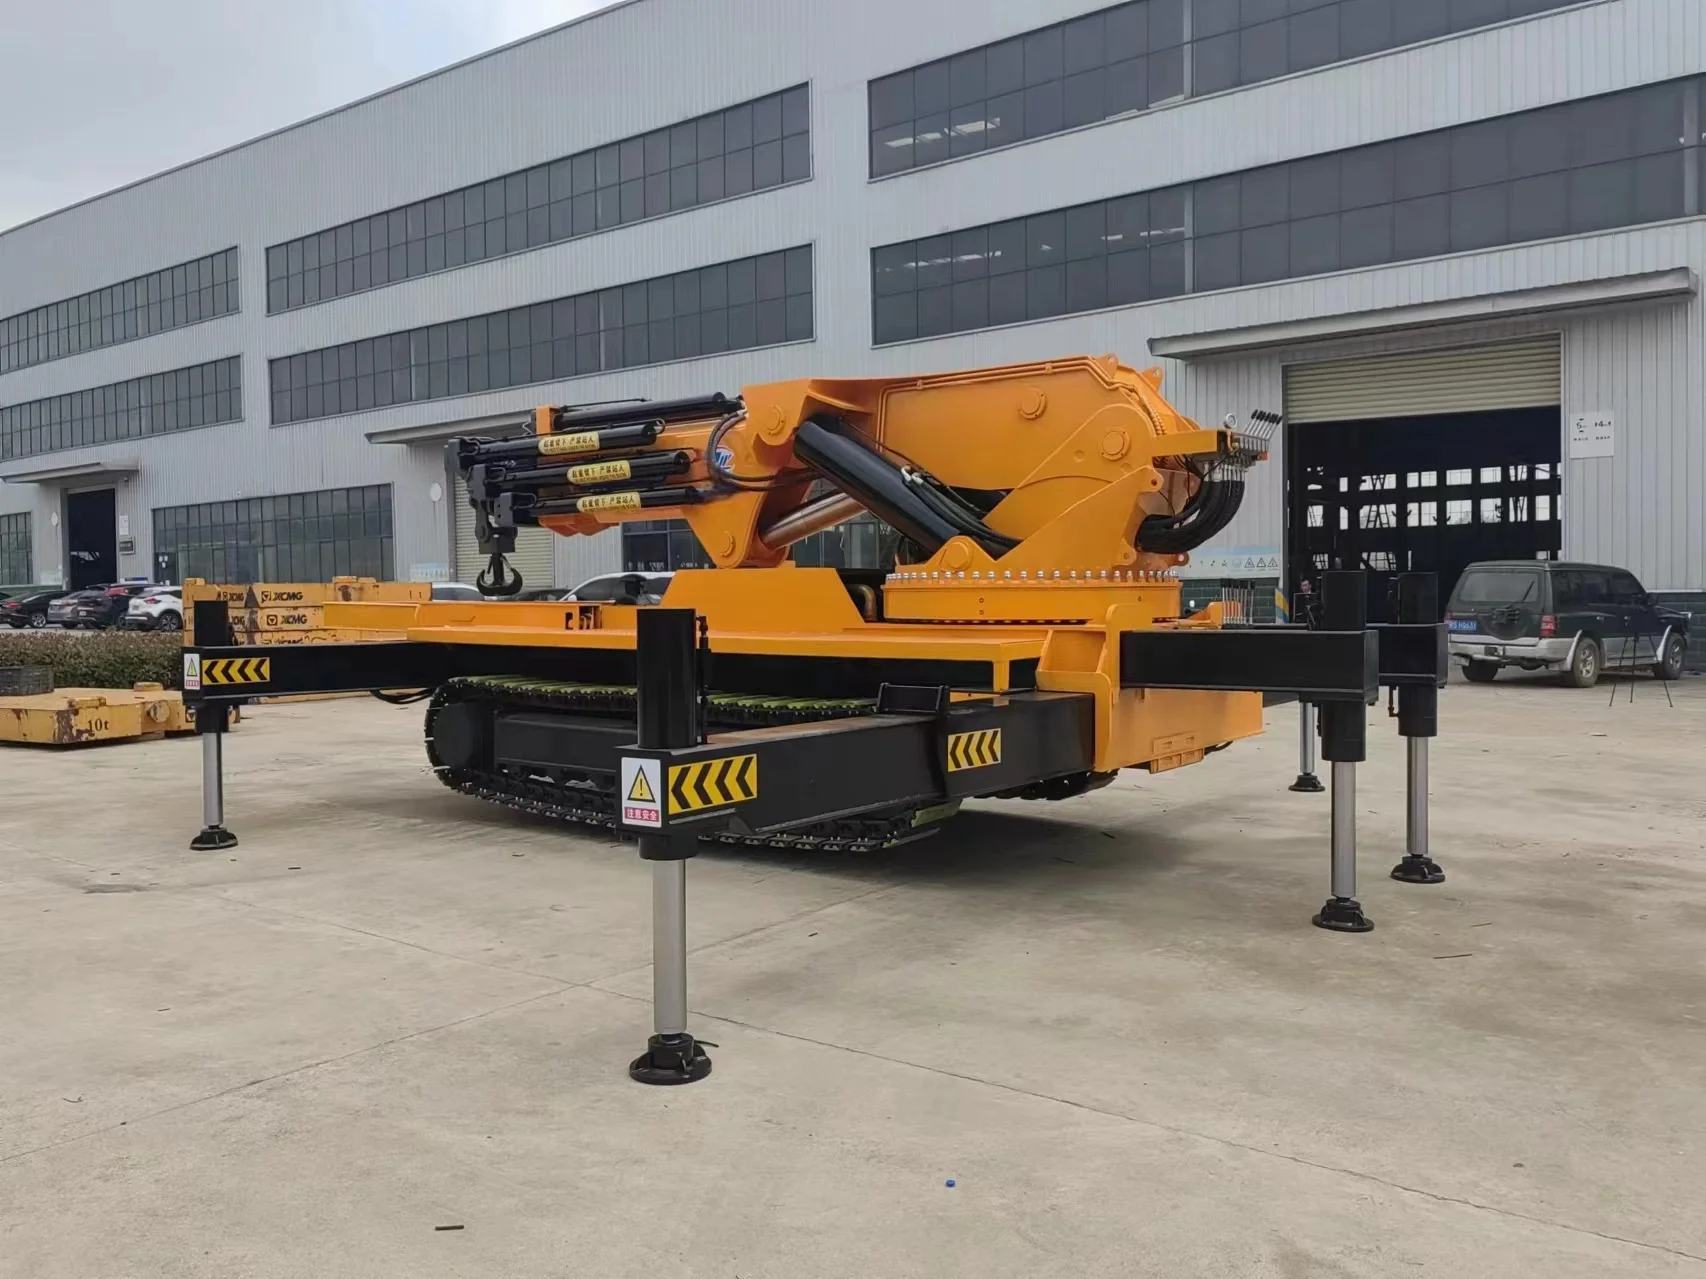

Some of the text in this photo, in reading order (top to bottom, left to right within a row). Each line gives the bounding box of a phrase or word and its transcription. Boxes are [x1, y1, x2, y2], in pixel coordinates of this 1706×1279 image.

[273, 592, 304, 601] XCMG
[280, 614, 308, 625] XCMG
[87, 718, 110, 731] 10t
[627, 808, 657, 820] 注意安全
